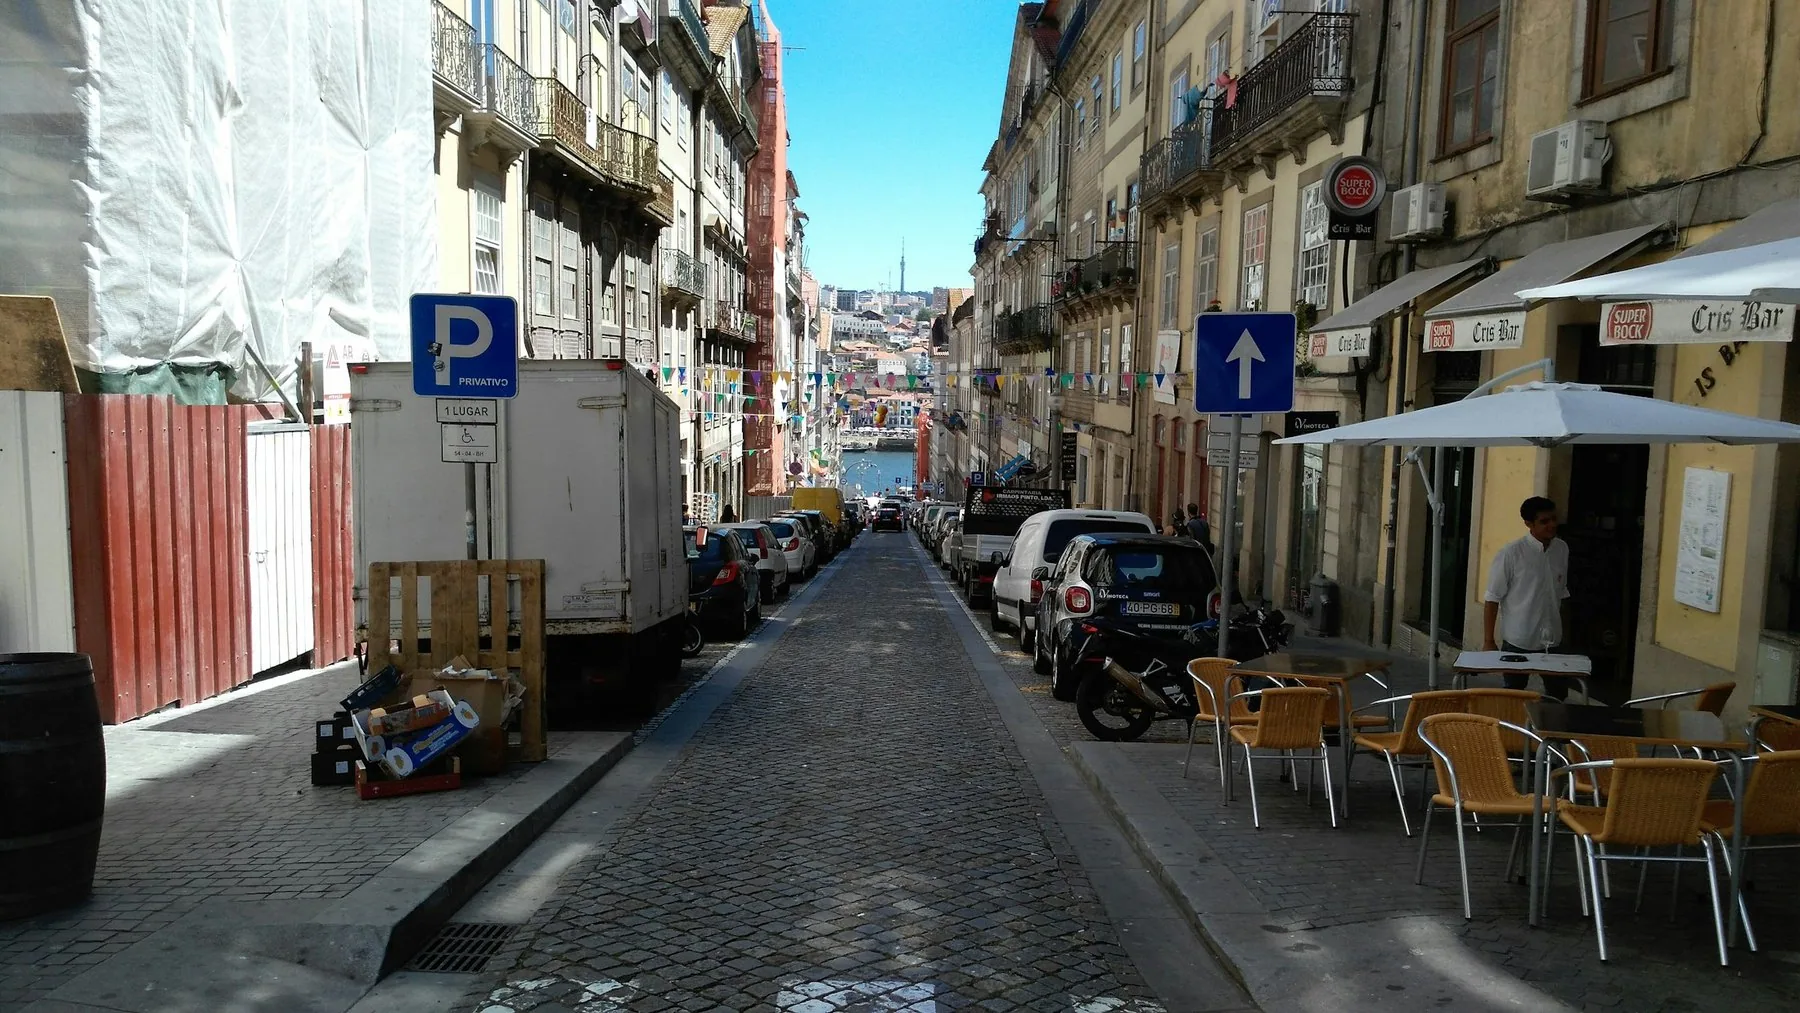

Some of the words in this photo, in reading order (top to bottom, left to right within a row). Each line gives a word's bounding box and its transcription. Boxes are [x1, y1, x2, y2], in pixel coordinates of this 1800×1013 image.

[1340, 178, 1371, 188] SUPER
[1341, 187, 1369, 196] BOCK
[1331, 223, 1350, 233] Cris
[1355, 223, 1372, 233] Bar
[1613, 308, 1646, 324] SUPER
[1691, 303, 1735, 334] Cris
[1740, 300, 1784, 331] Bar
[1433, 324, 1451, 337] SUPER
[1472, 321, 1496, 344] Cris
[1498, 318, 1520, 342] Bar
[1613, 324, 1644, 339] BOCK
[435, 304, 494, 386] P
[1338, 335, 1352, 352] Cris
[1353, 333, 1367, 351] Bar
[1433, 336, 1451, 348] BOCK
[458, 377, 509, 387] PRIVATIVO
[445, 406, 450, 416] 1
[452, 406, 489, 416] LUGAR
